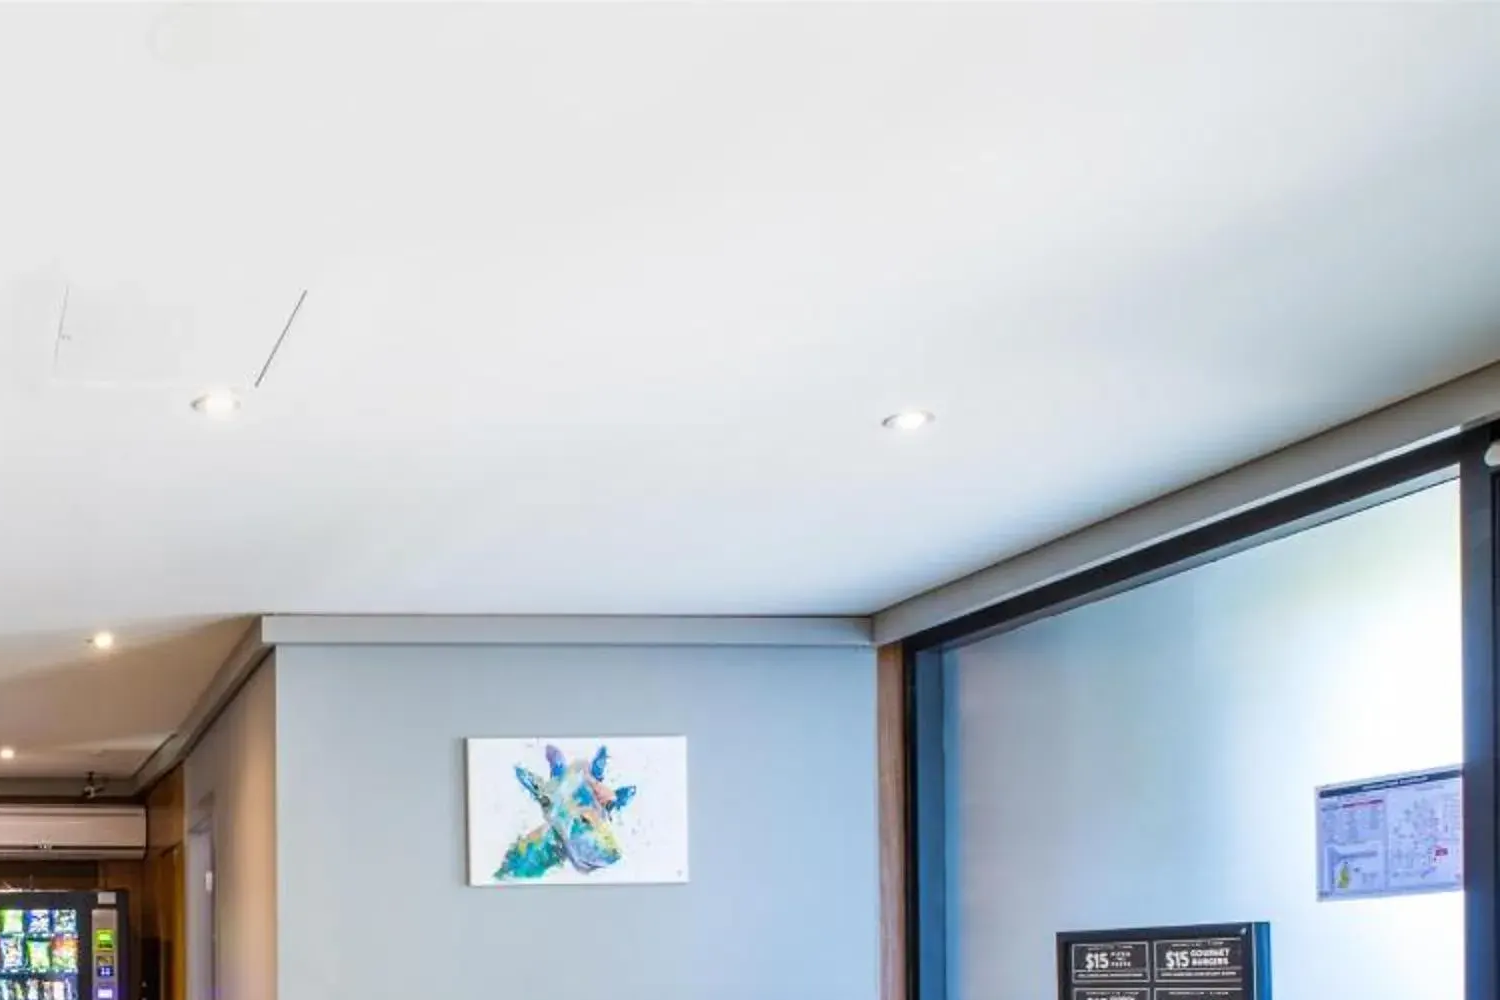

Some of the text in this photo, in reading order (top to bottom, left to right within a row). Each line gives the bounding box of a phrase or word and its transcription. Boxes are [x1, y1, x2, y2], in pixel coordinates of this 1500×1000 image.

[1165, 950, 1189, 969] $15
[1190, 948, 1230, 957] GOURMET
[1085, 952, 1109, 971] $15
[1191, 957, 1229, 965] BURGERS
